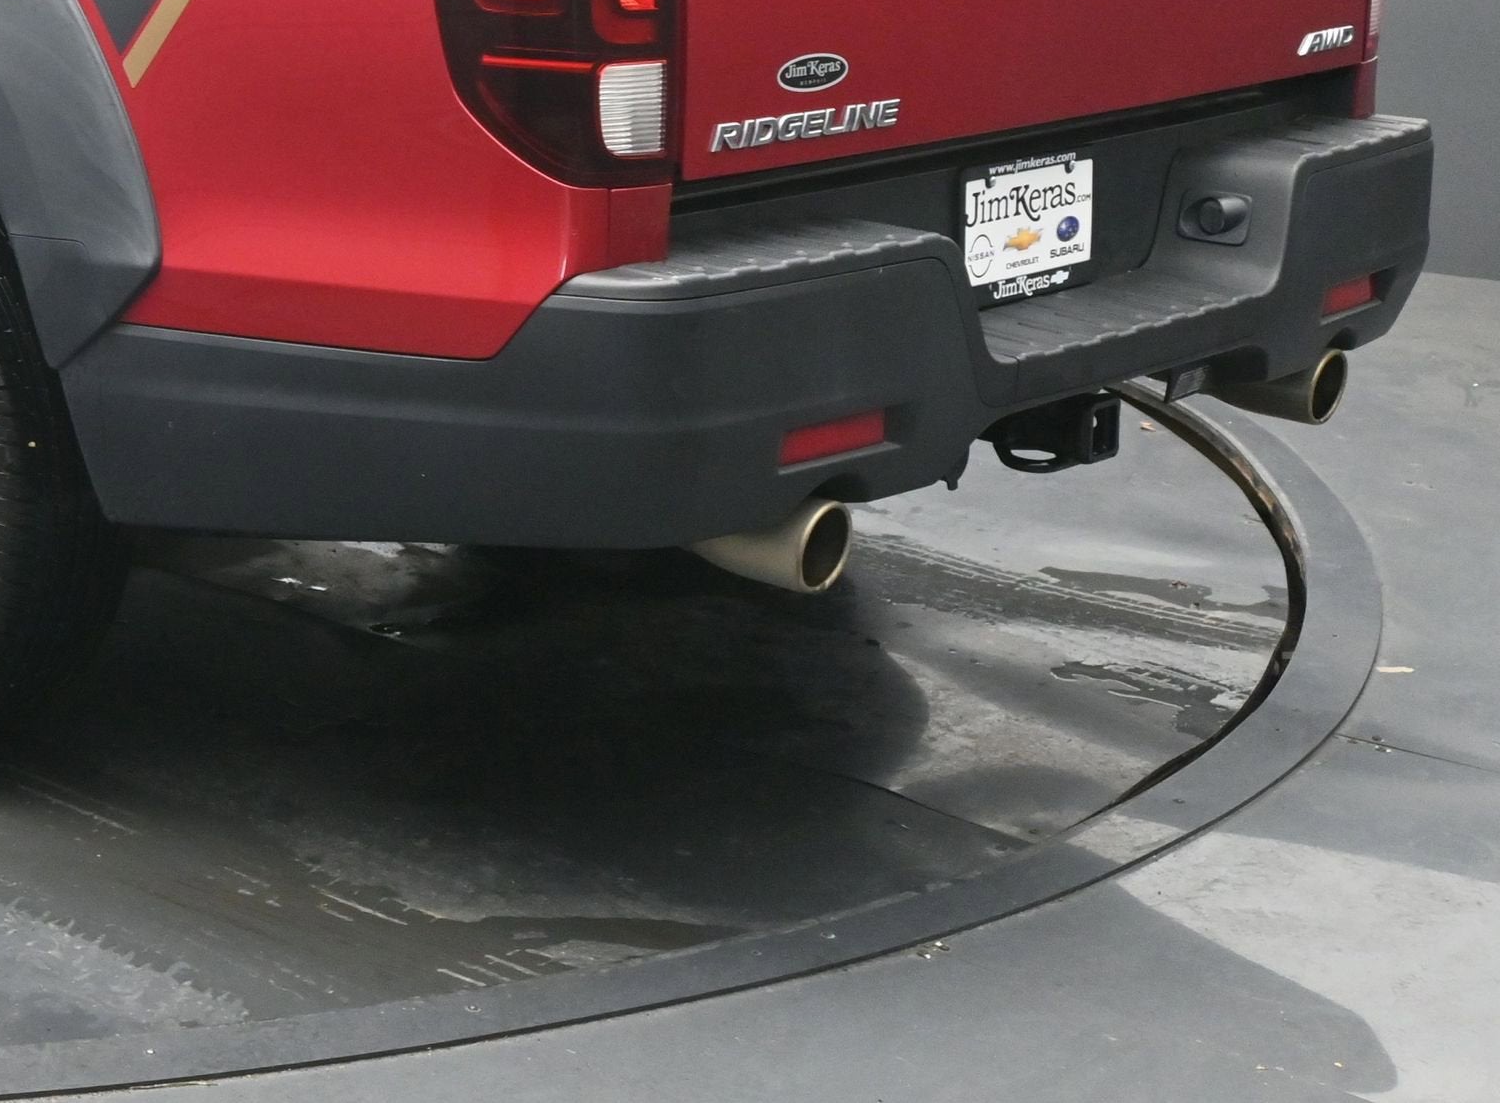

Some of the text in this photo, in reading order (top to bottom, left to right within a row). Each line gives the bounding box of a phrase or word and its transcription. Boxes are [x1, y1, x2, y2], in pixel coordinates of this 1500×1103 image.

[1297, 25, 1354, 56] AWD
[710, 98, 901, 153] RIDGELINE
[988, 152, 1076, 175] www.jimkeras.com
[967, 250, 995, 263] NISSAN
[1050, 243, 1084, 258] SUBARU
[1006, 256, 1039, 270] CHEVROLET
